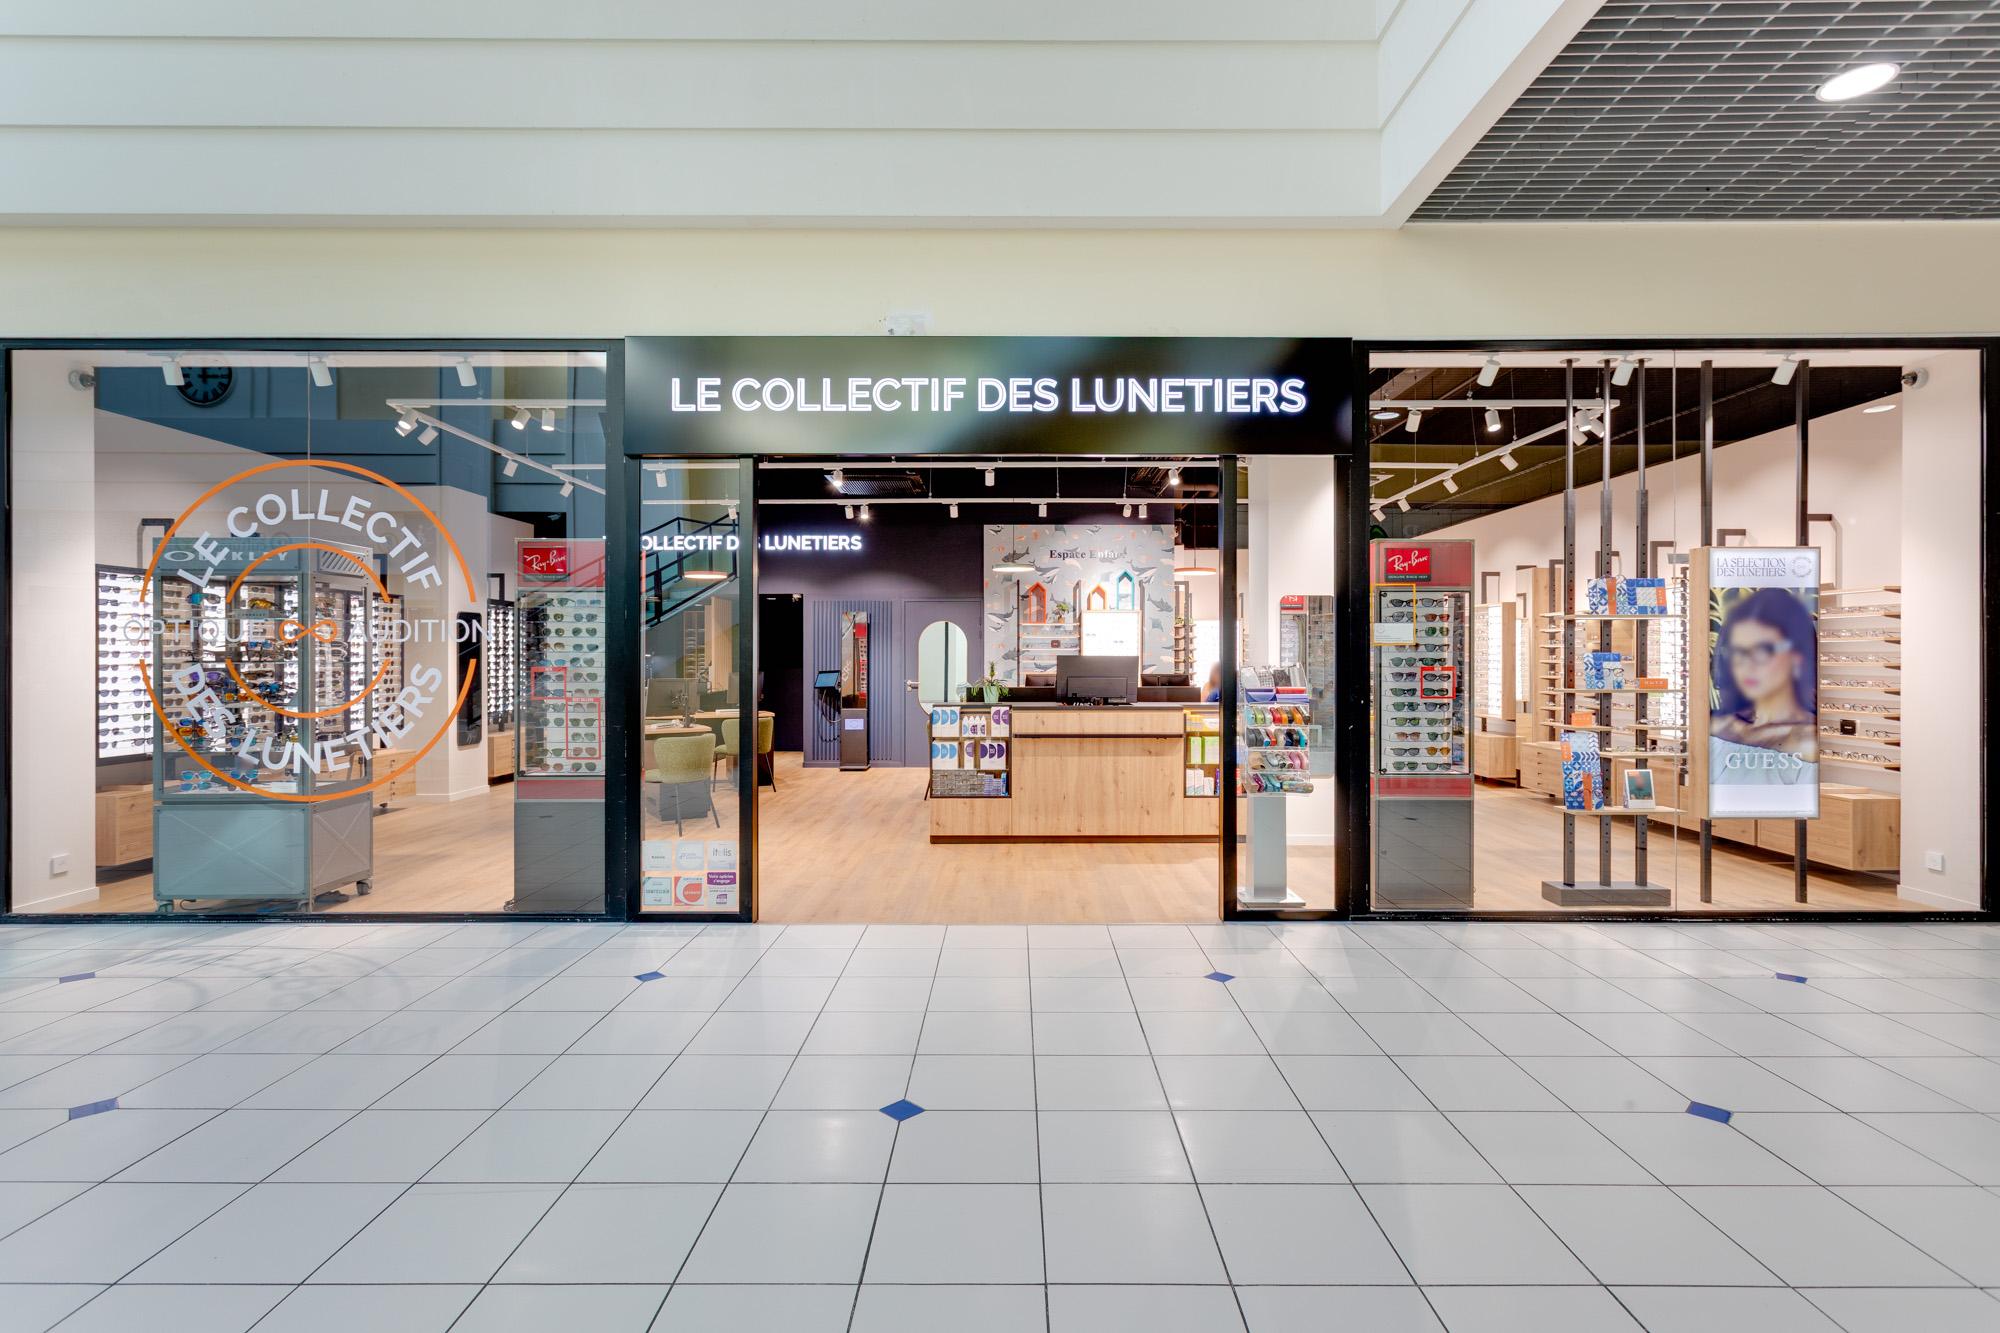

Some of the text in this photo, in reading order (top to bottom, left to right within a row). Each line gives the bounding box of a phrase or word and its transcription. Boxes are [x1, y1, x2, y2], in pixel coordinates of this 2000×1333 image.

[671, 377, 1308, 414] LE COLLECTIF DES LUNETIERS
[176, 488, 443, 590] LE COLLECTIF
[764, 534, 863, 551] LUNETIERS
[524, 549, 567, 572] Ray-Ban
[1049, 549, 1087, 561] Espace
[1388, 550, 1429, 571] Ray-Ban
[1716, 557, 1729, 568] LA
[1716, 567, 1787, 577] DES LUNETIERS
[123, 619, 493, 644] OPTIQUE AUDITION
[172, 662, 443, 774] DES LUNETIERS
[1724, 750, 1804, 770] GUESS
